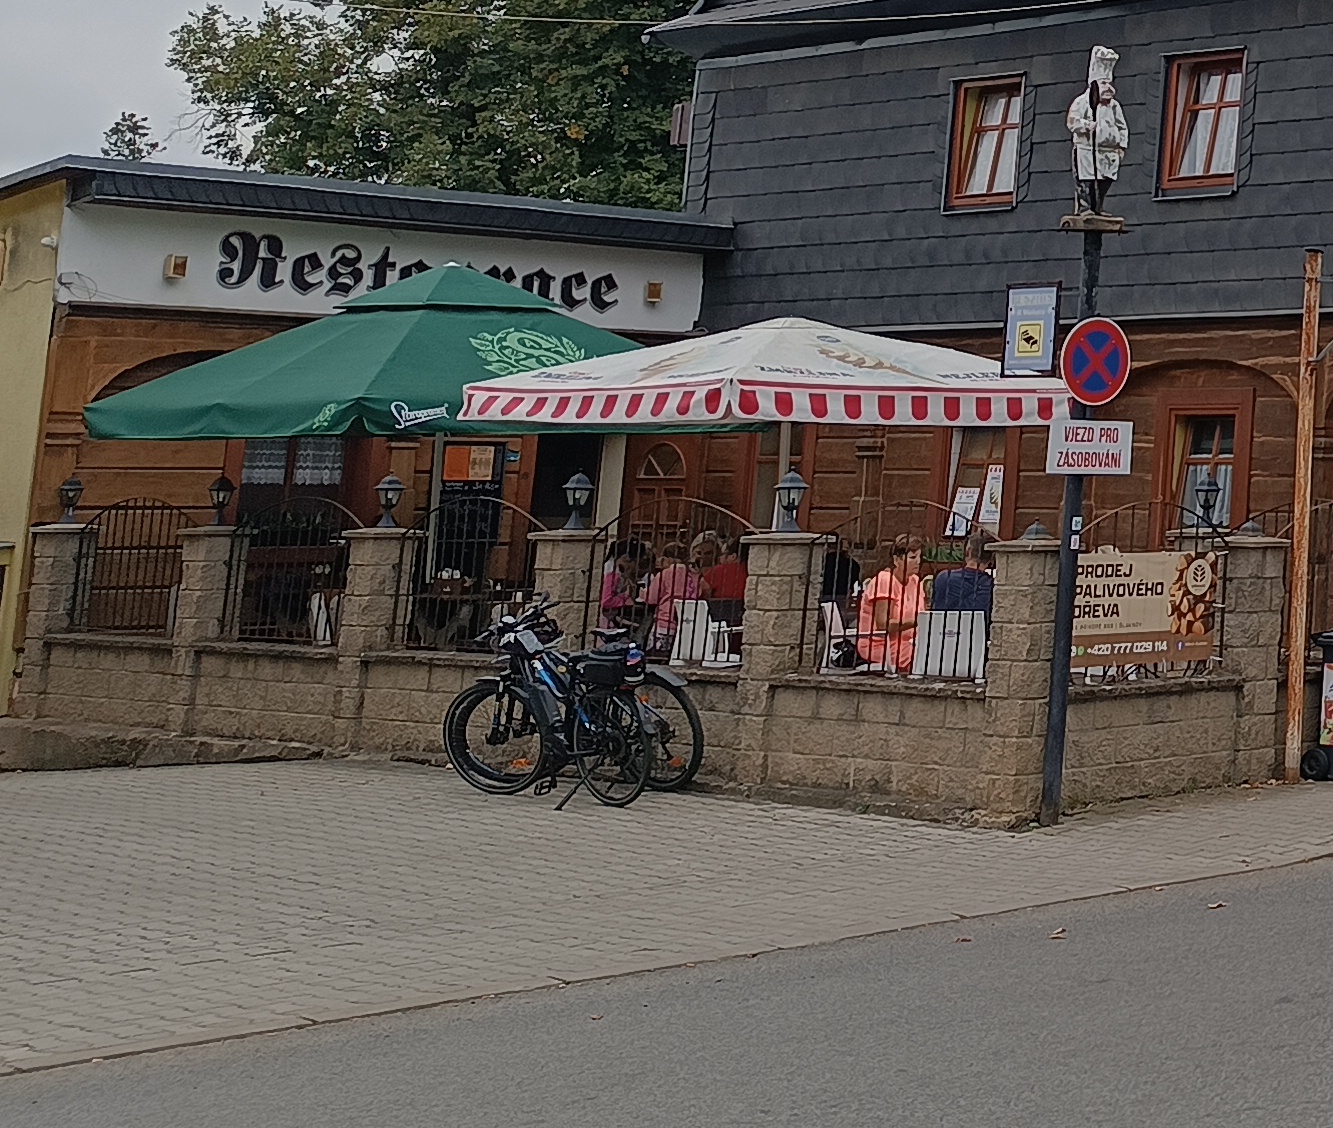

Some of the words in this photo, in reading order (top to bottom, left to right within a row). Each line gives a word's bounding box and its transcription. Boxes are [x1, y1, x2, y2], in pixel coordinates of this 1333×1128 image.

[215, 230, 619, 313] Restace
[1064, 426, 1095, 443] VJEZD
[1099, 427, 1119, 444] PRO
[1056, 448, 1122, 469] ZÁSOBOVÁNÍ
[1077, 563, 1133, 579] PRODEJ
[1075, 579, 1164, 599] PALIVOVÉHO
[1073, 601, 1120, 619] DŘEVA
[1087, 643, 1111, 655] +420
[1113, 642, 1132, 654] 777
